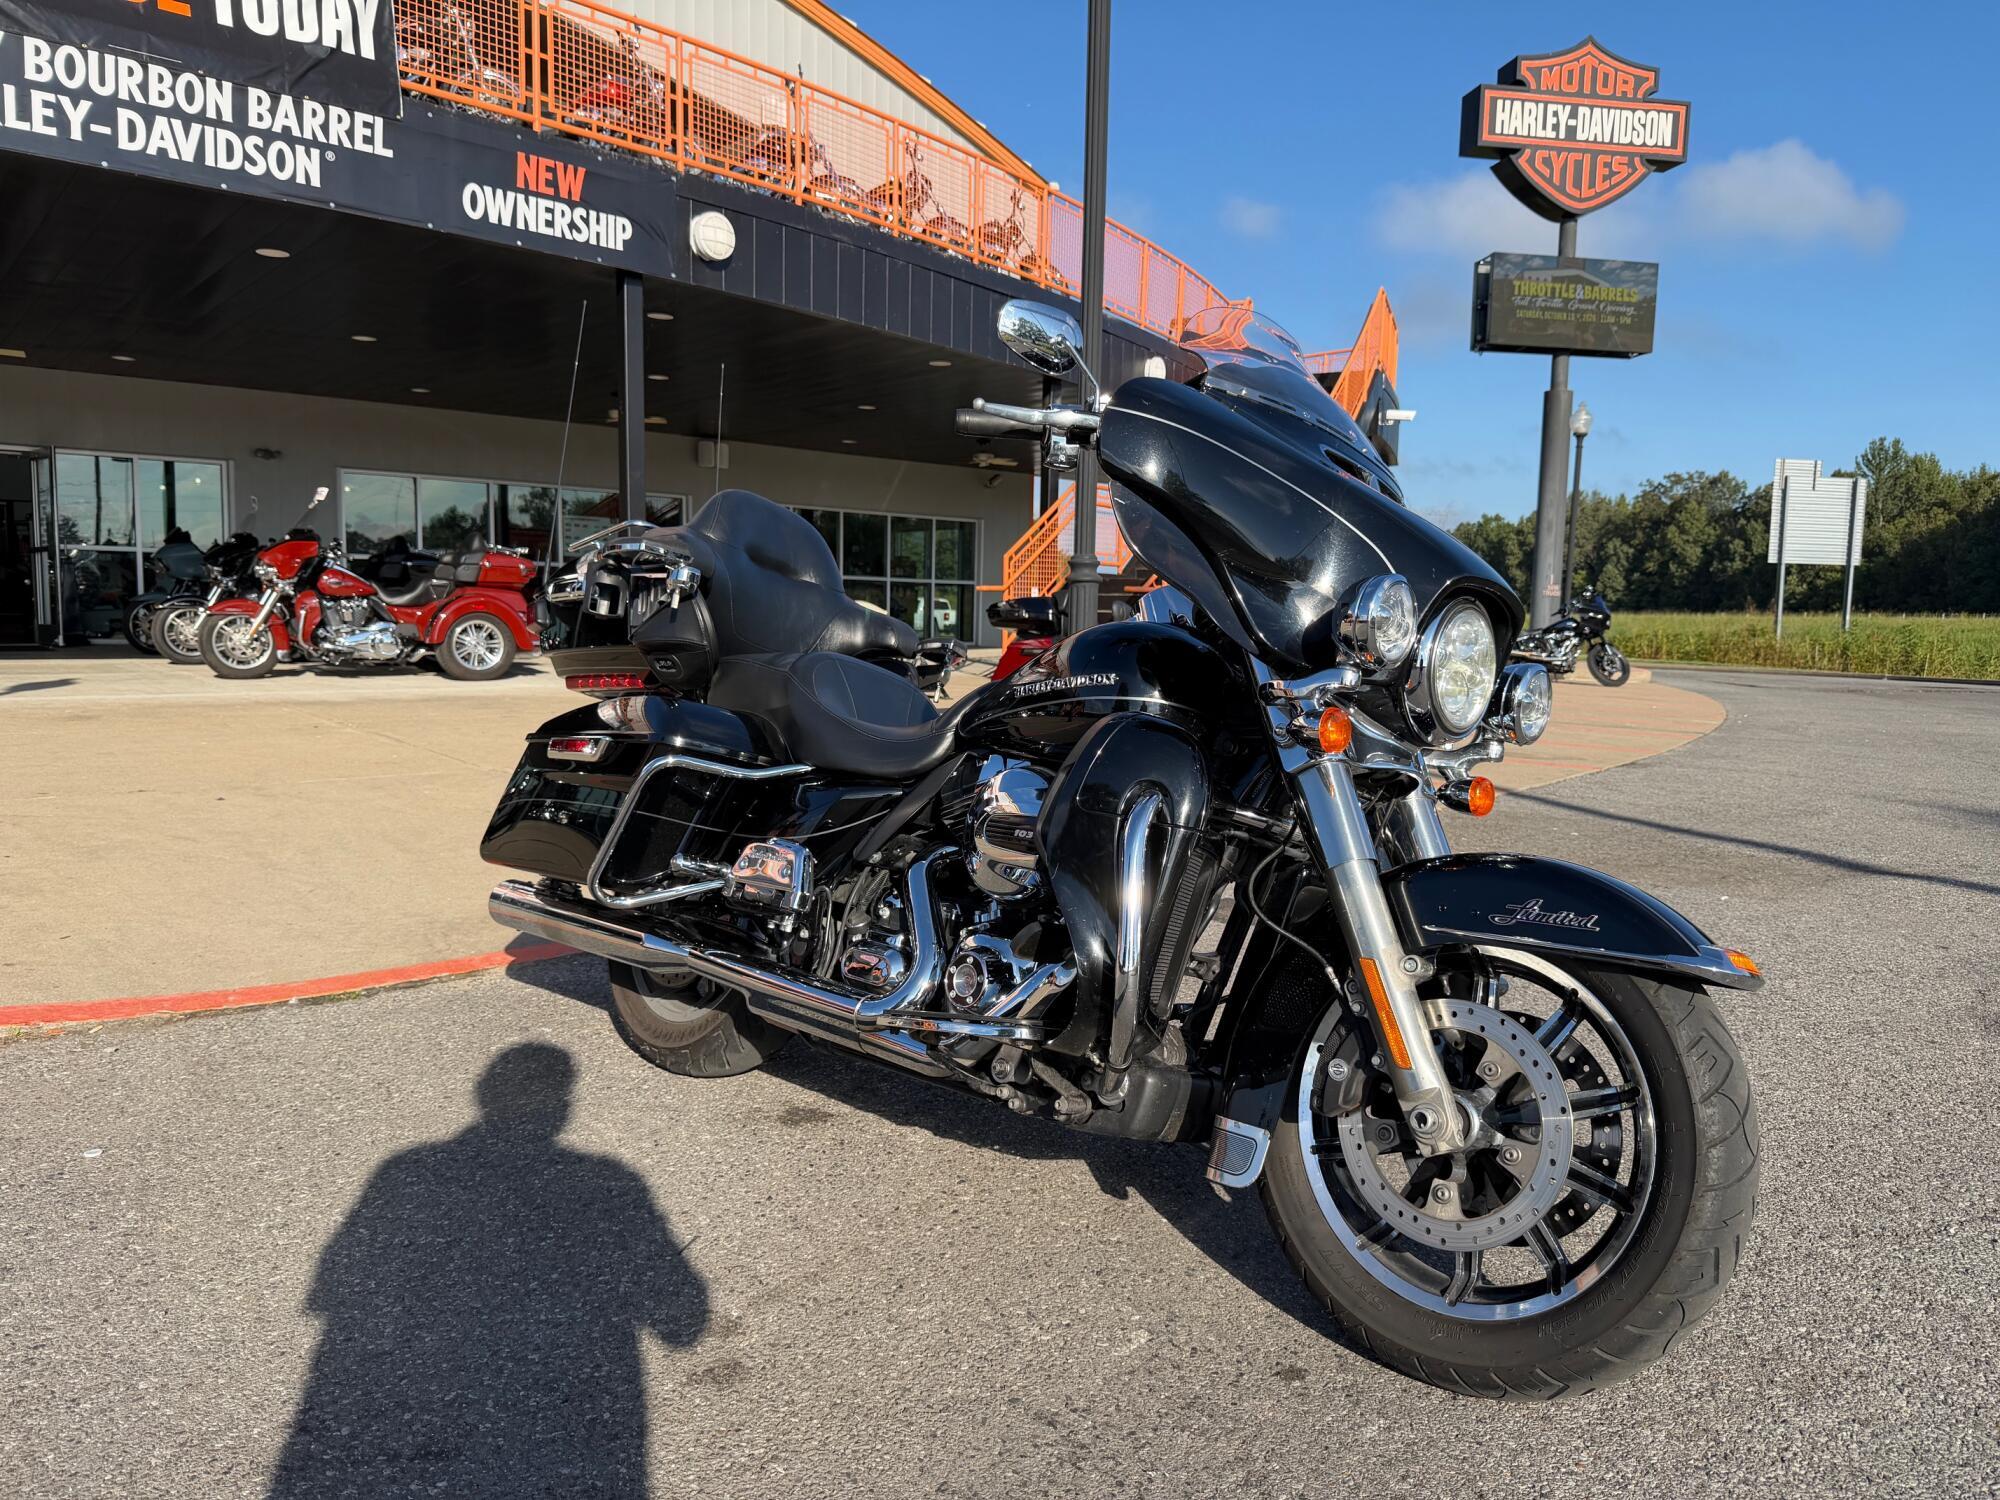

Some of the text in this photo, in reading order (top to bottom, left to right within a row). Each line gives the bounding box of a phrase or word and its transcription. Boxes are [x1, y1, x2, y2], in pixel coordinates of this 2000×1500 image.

[23, 35, 394, 159] BOURBON BARREL
[1541, 55, 1635, 97] MOTOR
[1495, 98, 1673, 147] HARLEY-DAVIDSON
[516, 151, 587, 202] NEW
[462, 182, 633, 251] OWNERSHIP
[1014, 829, 1034, 839] 103
[1488, 898, 1600, 932] Limited
